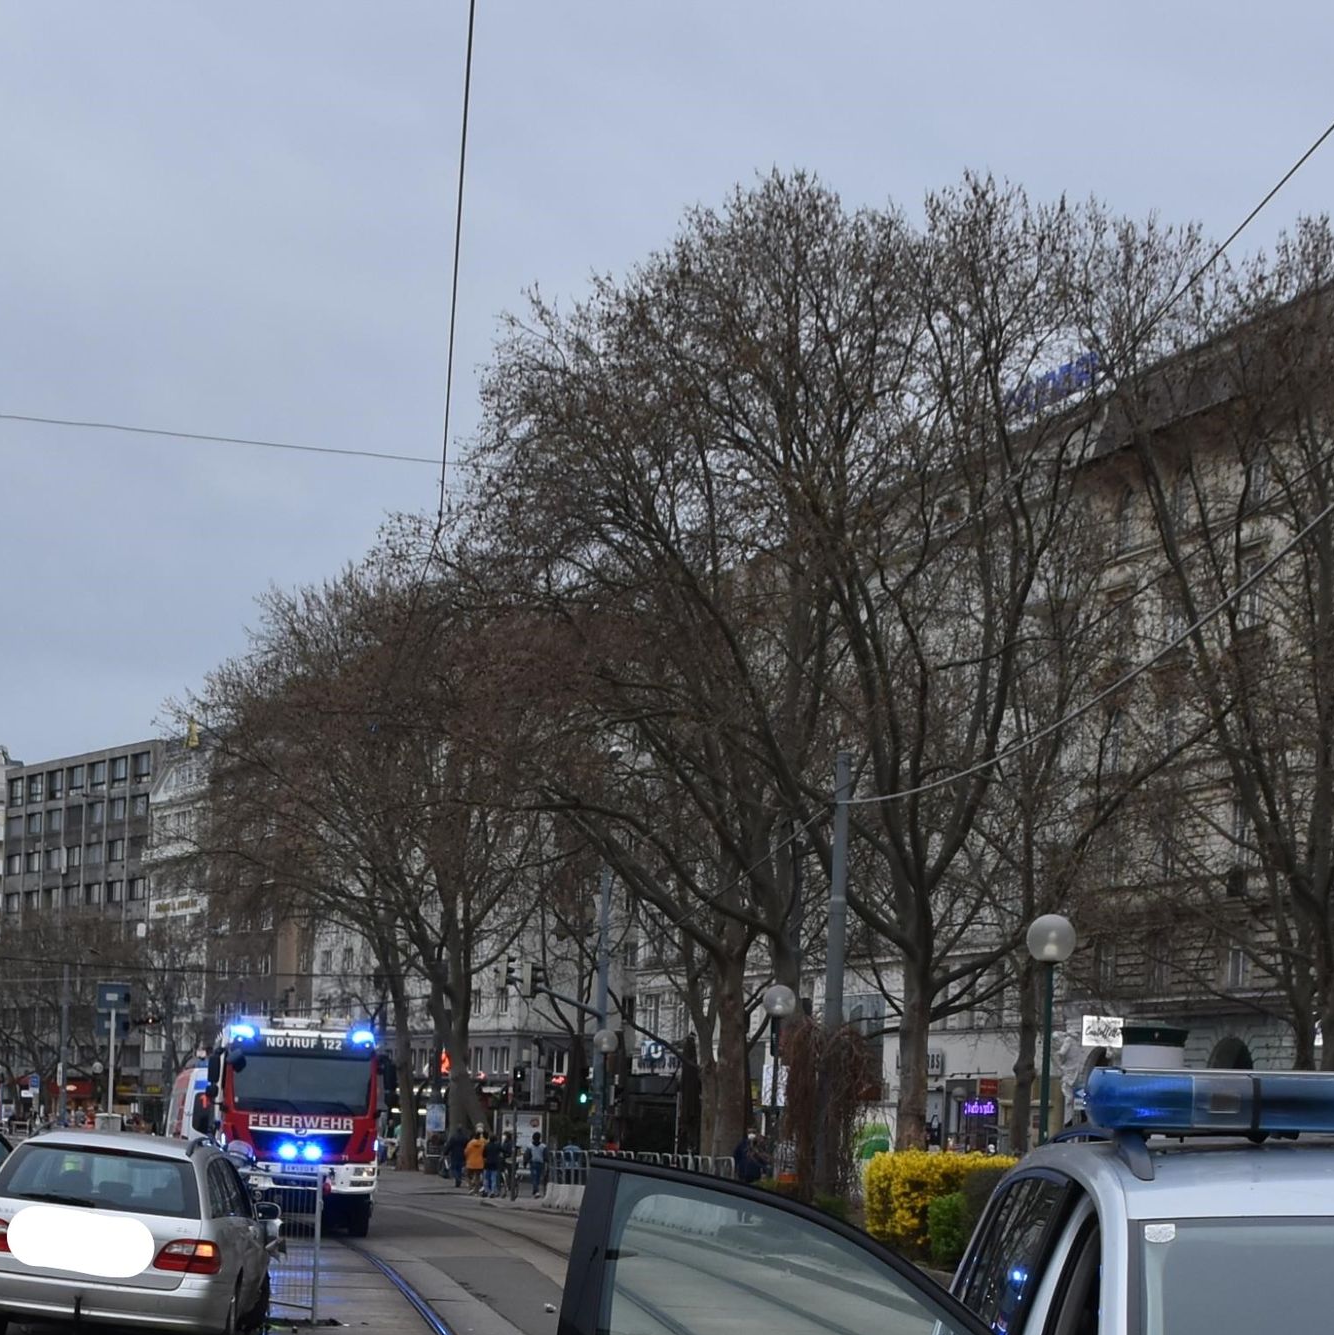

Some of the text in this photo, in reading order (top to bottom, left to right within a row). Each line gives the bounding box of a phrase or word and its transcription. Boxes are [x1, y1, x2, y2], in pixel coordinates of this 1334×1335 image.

[267, 1036, 342, 1050] NOTRUF 122
[248, 1114, 354, 1130] FEUERWEHR
